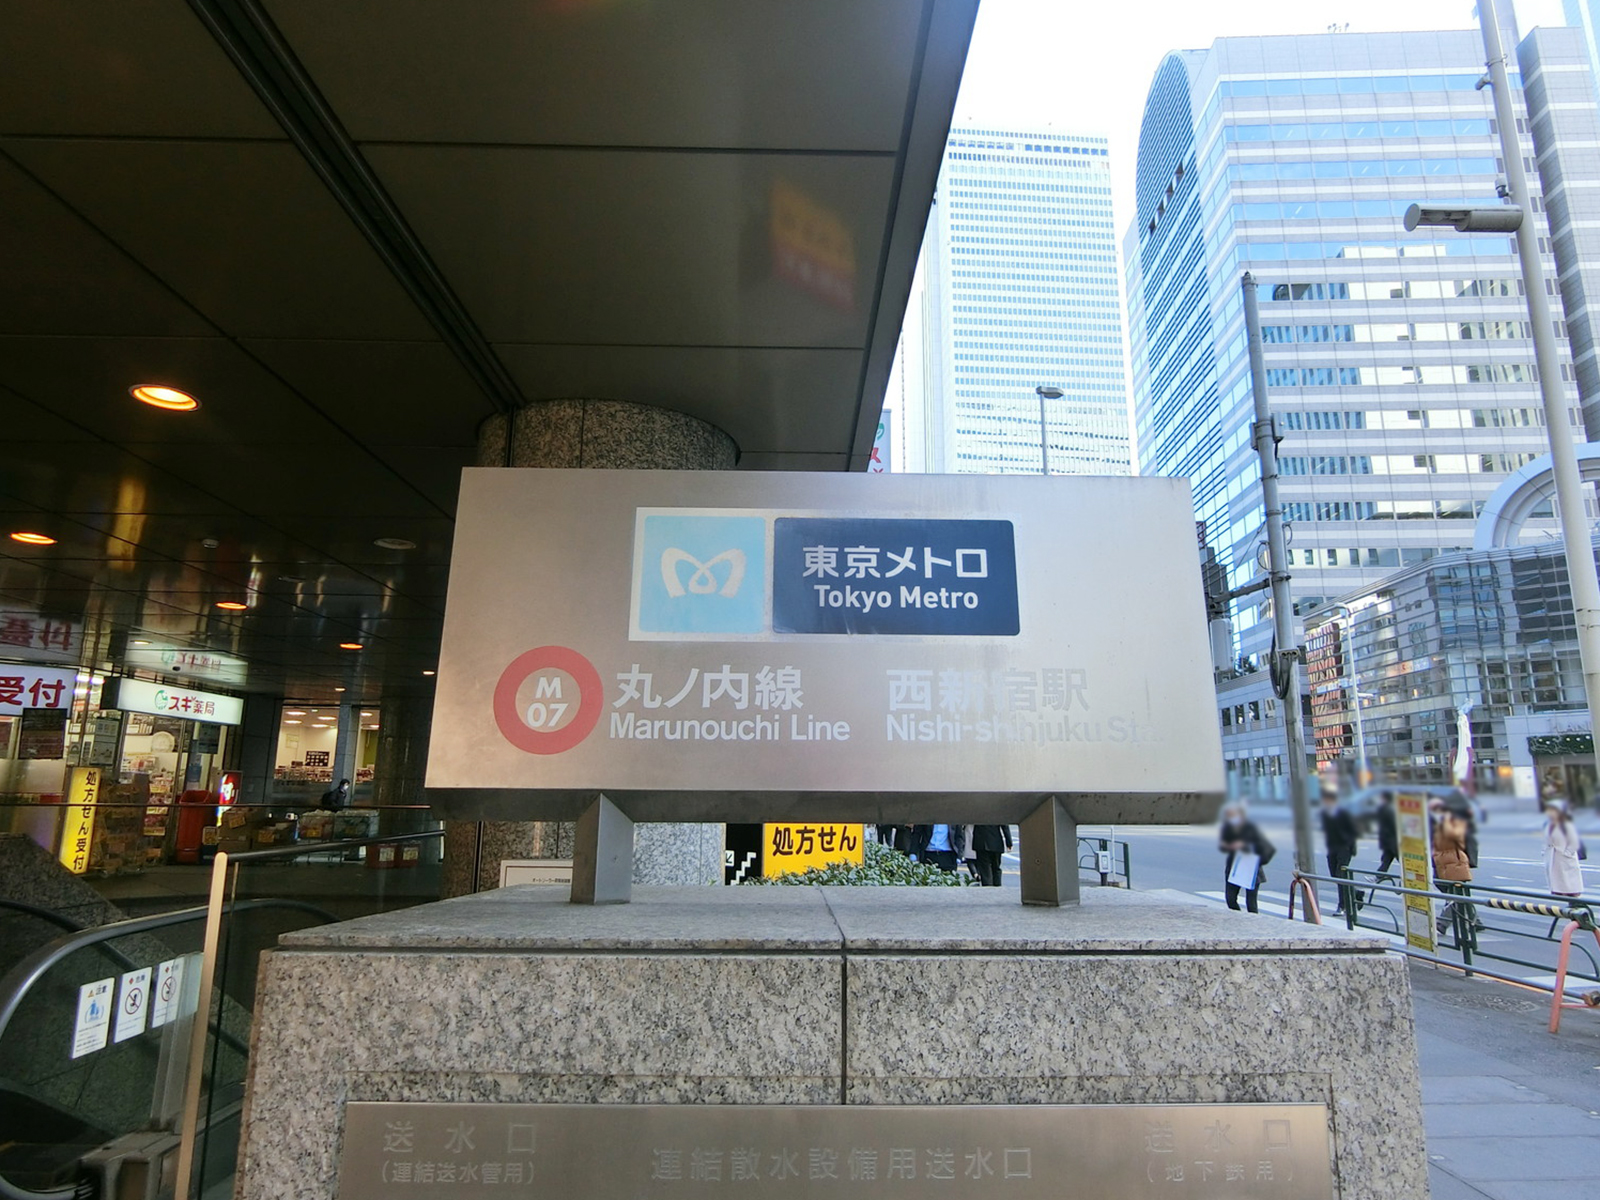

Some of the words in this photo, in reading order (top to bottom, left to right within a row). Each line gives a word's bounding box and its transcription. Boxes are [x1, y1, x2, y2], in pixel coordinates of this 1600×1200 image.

[802, 545, 989, 579] 東京メトロ
[813, 584, 892, 613] Tokyo
[899, 585, 979, 609] Metro
[535, 676, 562, 699] M
[612, 664, 804, 711] 丸ノ内線
[886, 667, 1090, 712] 西新宿駅
[168, 695, 215, 716] スギ薬局
[526, 703, 569, 728] 07
[610, 712, 780, 741] Marunouchi
[791, 713, 851, 741] Line
[886, 713, 1103, 747] Nishi-shinjuku
[73, 771, 97, 871] 処方せん受付
[772, 826, 857, 856] 処方せん
[383, 1120, 538, 1154] 送水口
[1145, 1119, 1292, 1153] 送水口
[651, 1146, 1033, 1182] 連結散水設備用送水口
